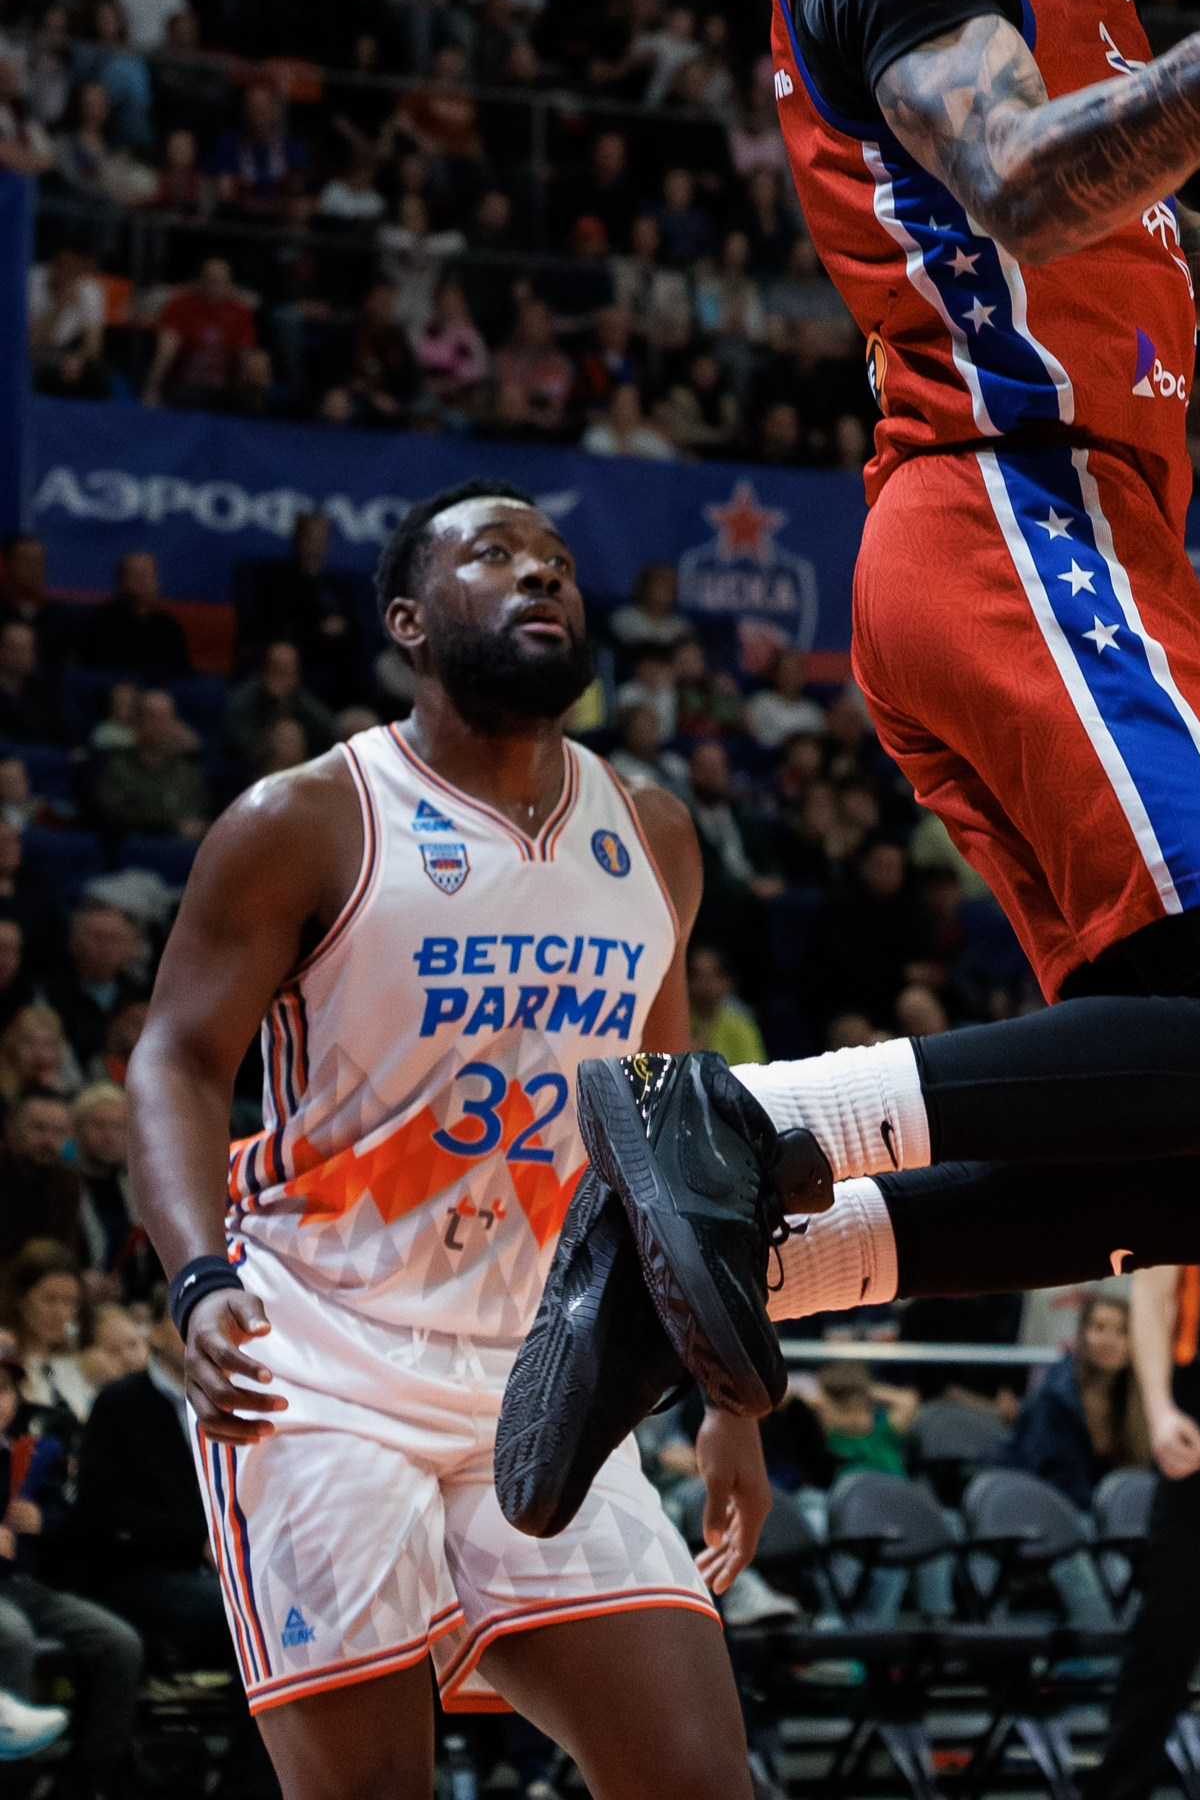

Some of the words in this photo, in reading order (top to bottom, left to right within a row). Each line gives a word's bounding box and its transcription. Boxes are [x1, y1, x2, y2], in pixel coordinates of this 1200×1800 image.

[413, 934, 644, 981] BETCITY
[420, 986, 642, 1040] PARMA
[432, 1061, 569, 1163] 32
